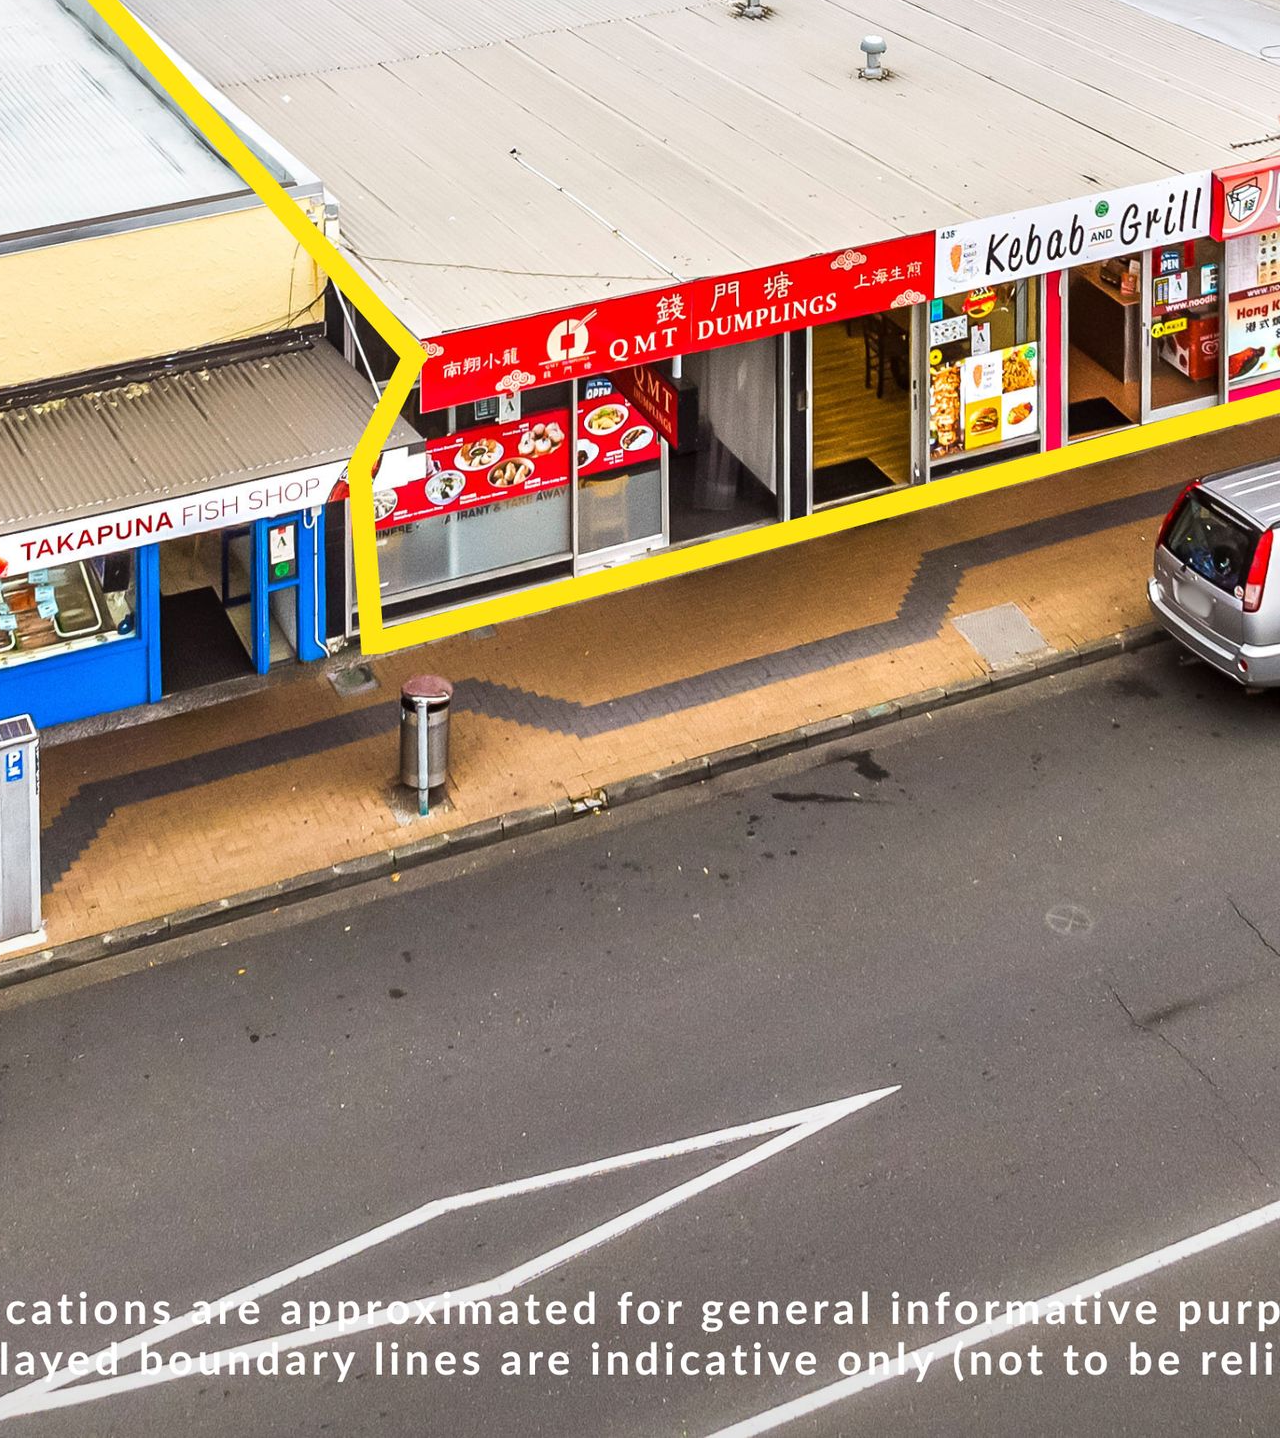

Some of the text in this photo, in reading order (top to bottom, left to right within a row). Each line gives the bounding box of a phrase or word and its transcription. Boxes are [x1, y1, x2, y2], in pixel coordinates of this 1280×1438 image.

[985, 214, 1085, 276] Kebab
[1090, 228, 1113, 243] AND
[1120, 187, 1202, 246] Grill
[608, 292, 838, 363] QMT DUMPLINGS
[1236, 304, 1269, 321] Hong
[633, 365, 673, 414] QMT
[21, 476, 321, 561] TAKAPUNA FISH SHOP
